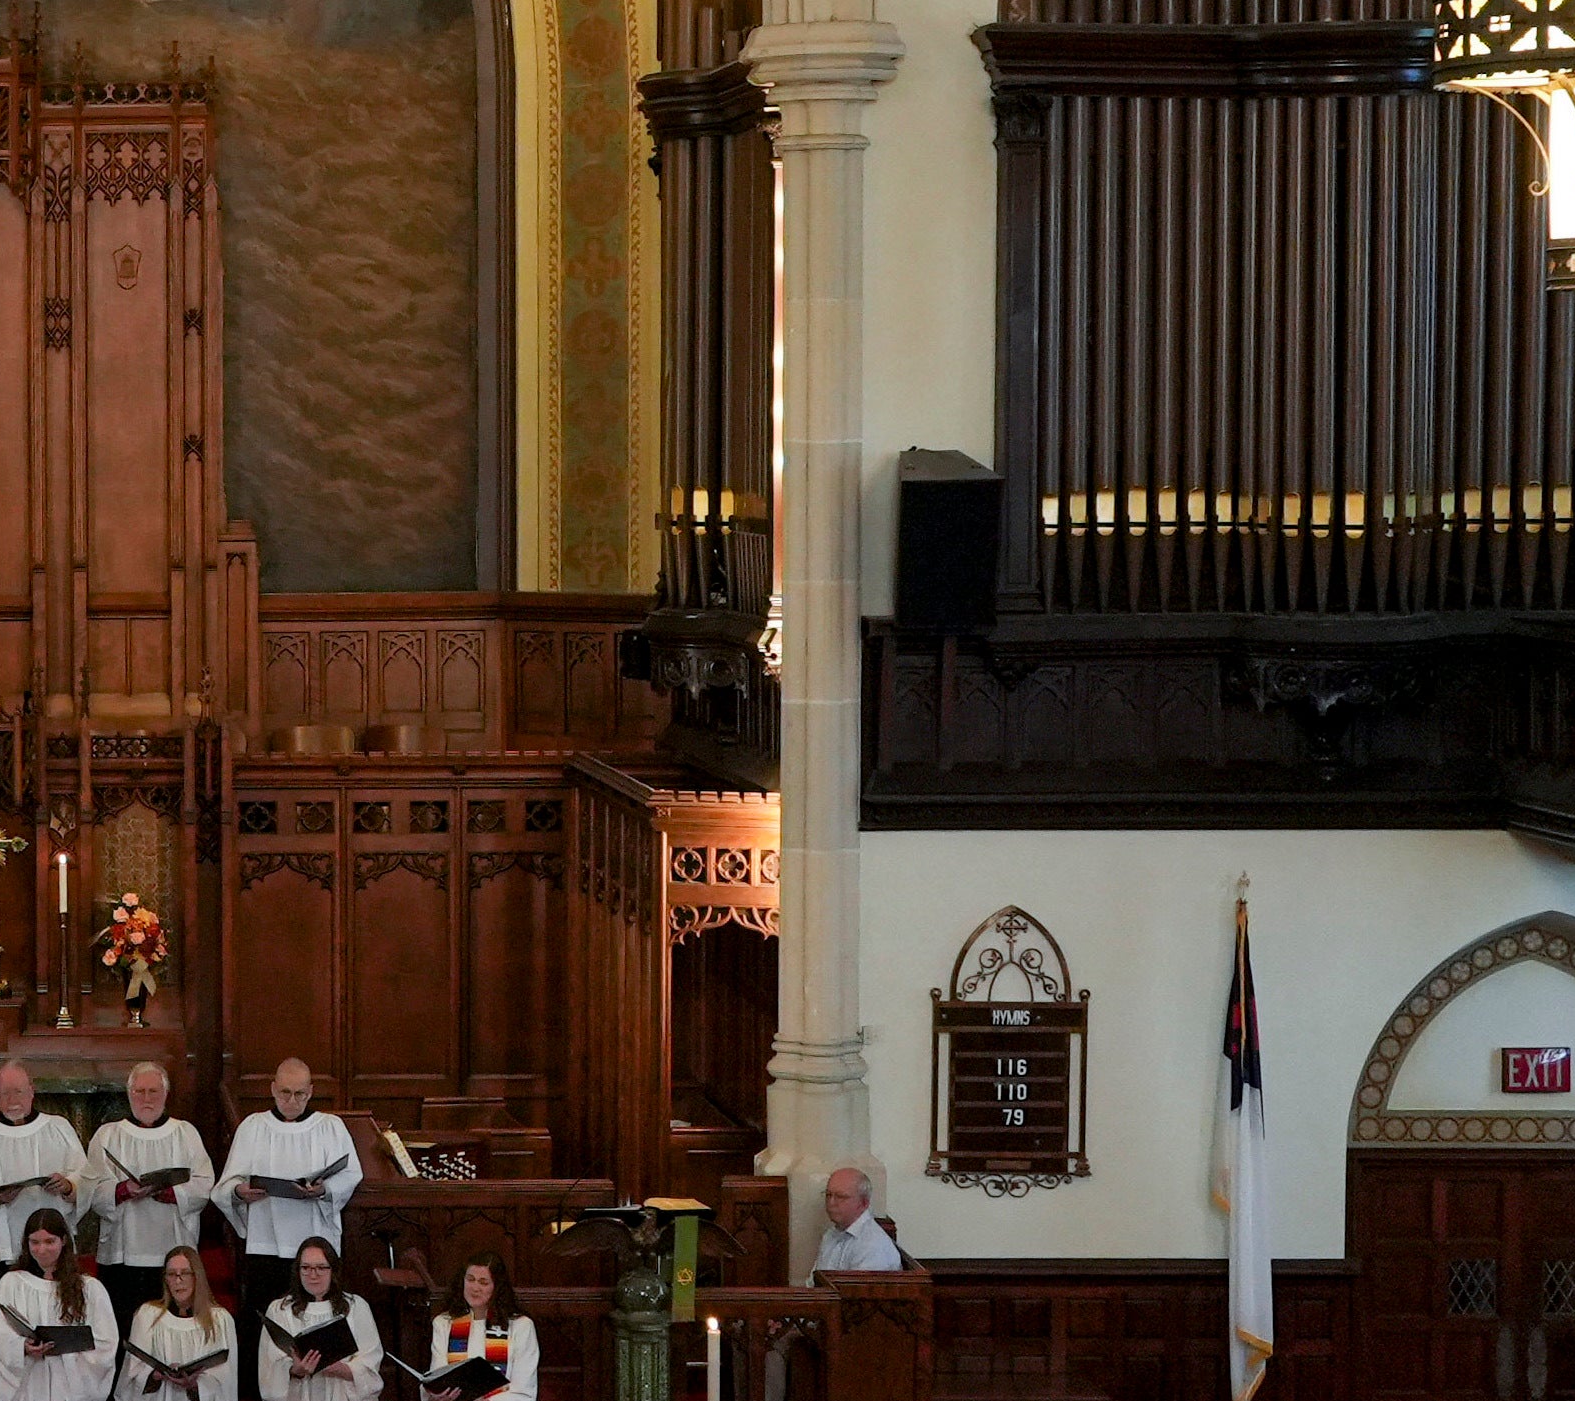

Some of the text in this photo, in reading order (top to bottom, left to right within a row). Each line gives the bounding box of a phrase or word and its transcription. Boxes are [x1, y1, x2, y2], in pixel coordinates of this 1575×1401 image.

[992, 1010, 1031, 1026] HYMNS
[997, 1059, 1028, 1076] 116
[1508, 1053, 1565, 1088] EXIT
[997, 1084, 1028, 1101] 110
[1003, 1109, 1024, 1126] 79
